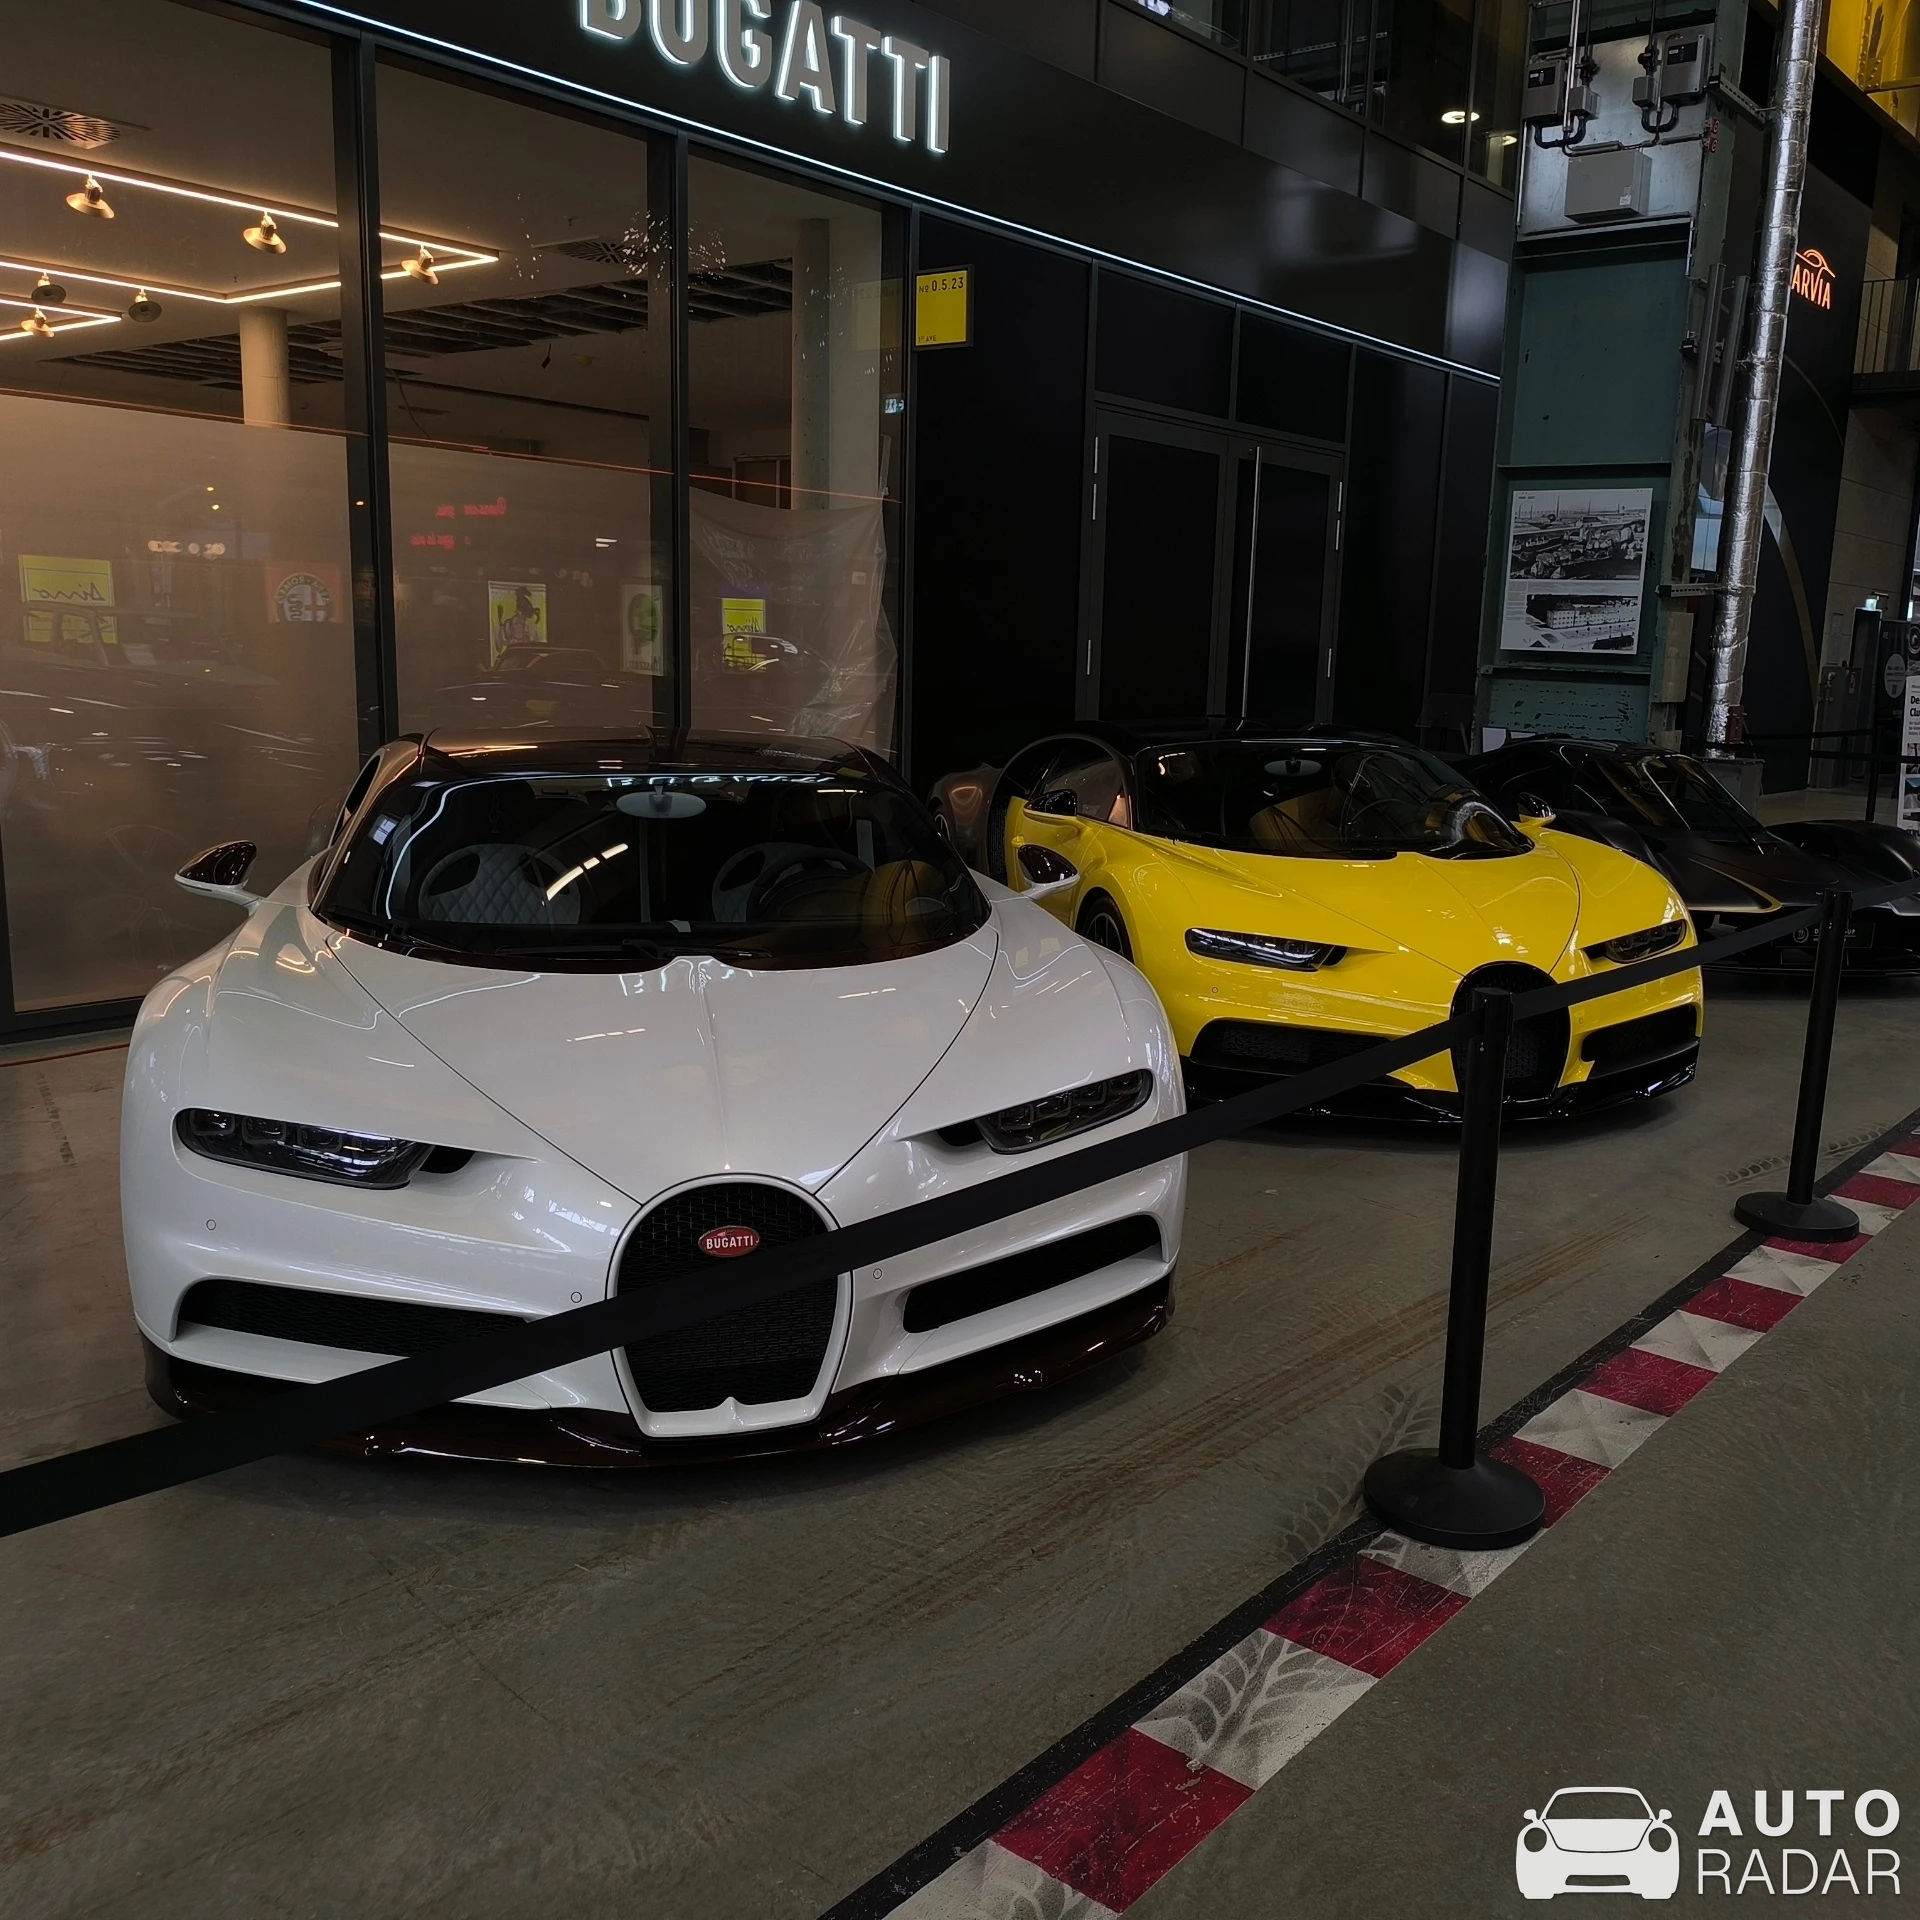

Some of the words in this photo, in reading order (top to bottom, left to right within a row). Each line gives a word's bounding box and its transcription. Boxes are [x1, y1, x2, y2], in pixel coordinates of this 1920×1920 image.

[931, 277, 964, 291] 0.5.23
[1791, 263, 1831, 310] ARVIA
[926, 334, 936, 342] AVE
[706, 1235, 753, 1249] BUGATTI
